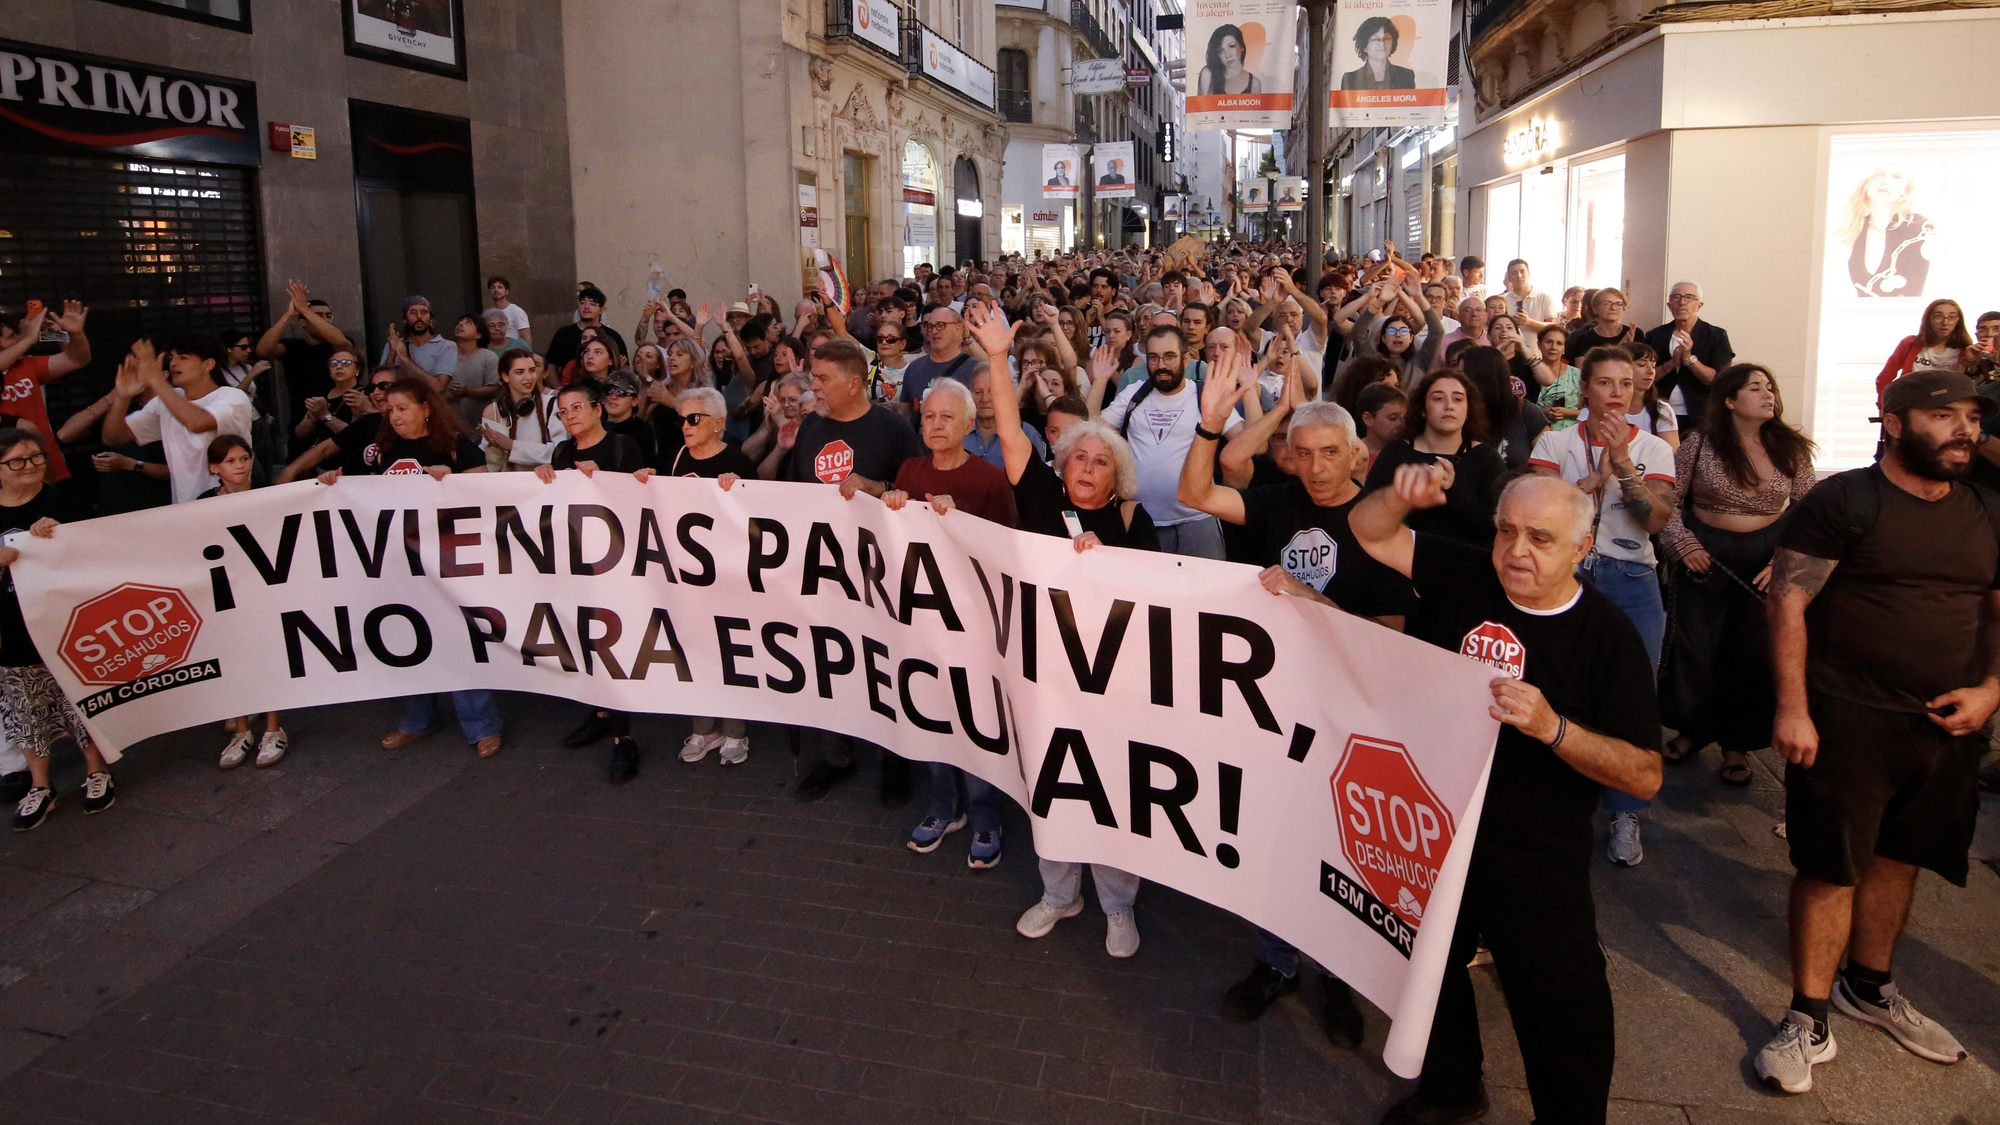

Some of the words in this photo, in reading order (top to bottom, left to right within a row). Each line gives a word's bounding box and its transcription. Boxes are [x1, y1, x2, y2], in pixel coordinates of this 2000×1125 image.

[1196, 1, 1231, 10] Inventar
[1196, 9, 1204, 18] la
[1344, 1, 1352, 9] la
[388, 33, 427, 48] GIVENCHY
[0, 52, 246, 130] PRIMOR
[1356, 94, 1392, 103] ÁNGELES
[1393, 94, 1417, 102] MORA
[818, 450, 851, 471] STOP
[1287, 545, 1331, 570] STOP
[74, 596, 174, 663] STOP
[93, 619, 192, 679] DESAHUCIOS
[203, 504, 716, 612] ¡VIVIENDAS
[747, 517, 966, 632] PARA
[968, 555, 1316, 764] VIVIR,
[1466, 634, 1520, 662] STOP
[79, 692, 114, 717] 15M
[118, 663, 217, 699] CÓRDOBA
[281, 603, 433, 679] NO
[459, 603, 694, 682] PARA
[714, 615, 1243, 869] ESPECUAR!
[1346, 781, 1441, 859] STOP
[1355, 839, 1440, 891] DESAHUCIO
[1327, 873, 1364, 913] 15M
